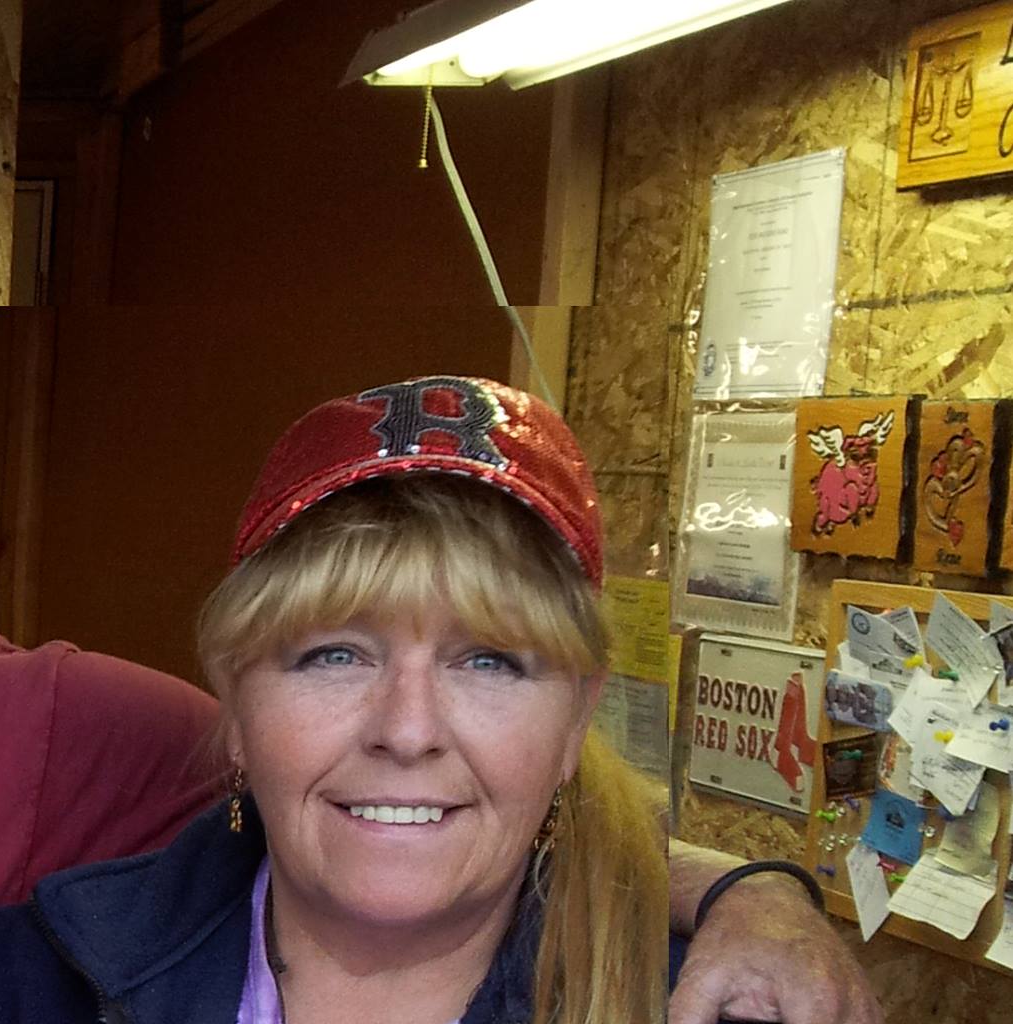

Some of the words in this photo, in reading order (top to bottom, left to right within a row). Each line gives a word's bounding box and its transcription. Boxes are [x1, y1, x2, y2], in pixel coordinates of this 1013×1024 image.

[698, 675, 778, 720] BOSTON
[694, 714, 728, 752] RED
[735, 724, 775, 762] SOX
